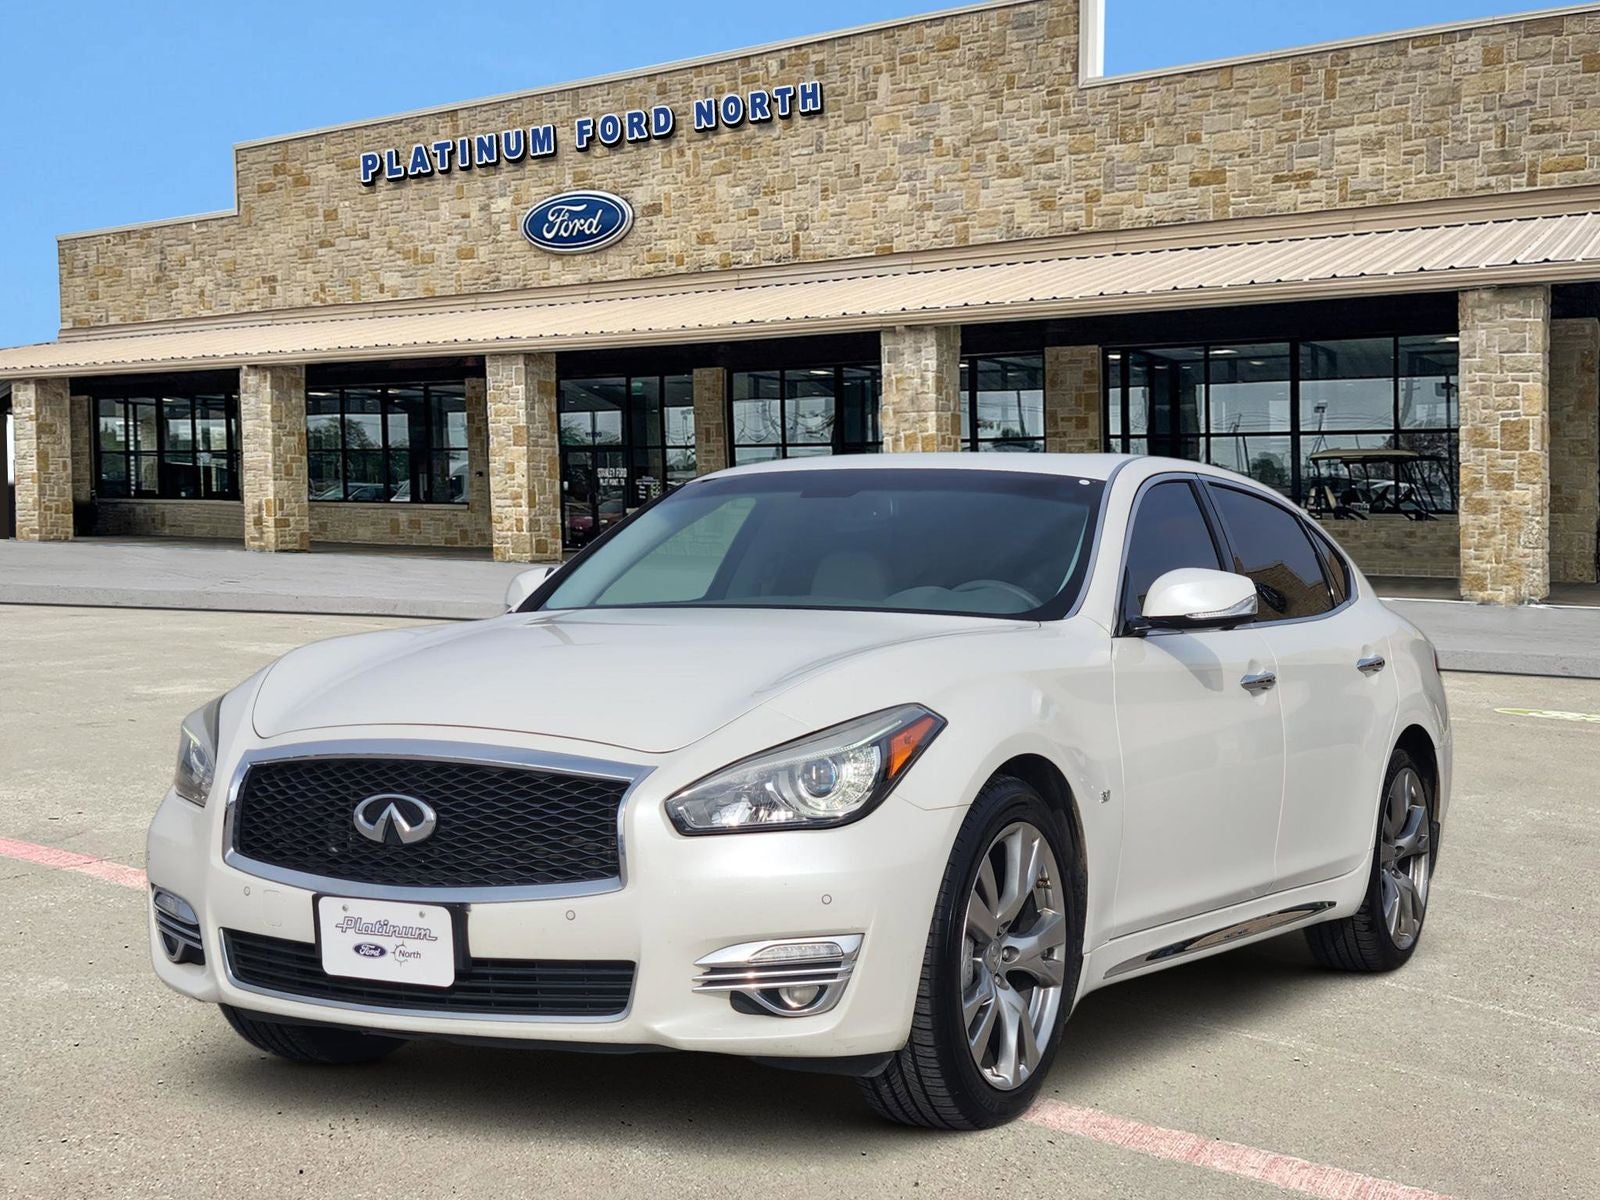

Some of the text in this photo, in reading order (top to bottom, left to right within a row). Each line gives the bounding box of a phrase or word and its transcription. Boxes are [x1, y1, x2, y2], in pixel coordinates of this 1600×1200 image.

[360, 81, 822, 185] PLATINUM FORD NORTH
[543, 203, 602, 239] Ford
[335, 916, 438, 941] Platinum
[359, 944, 381, 958] Ford
[398, 949, 421, 959] North
